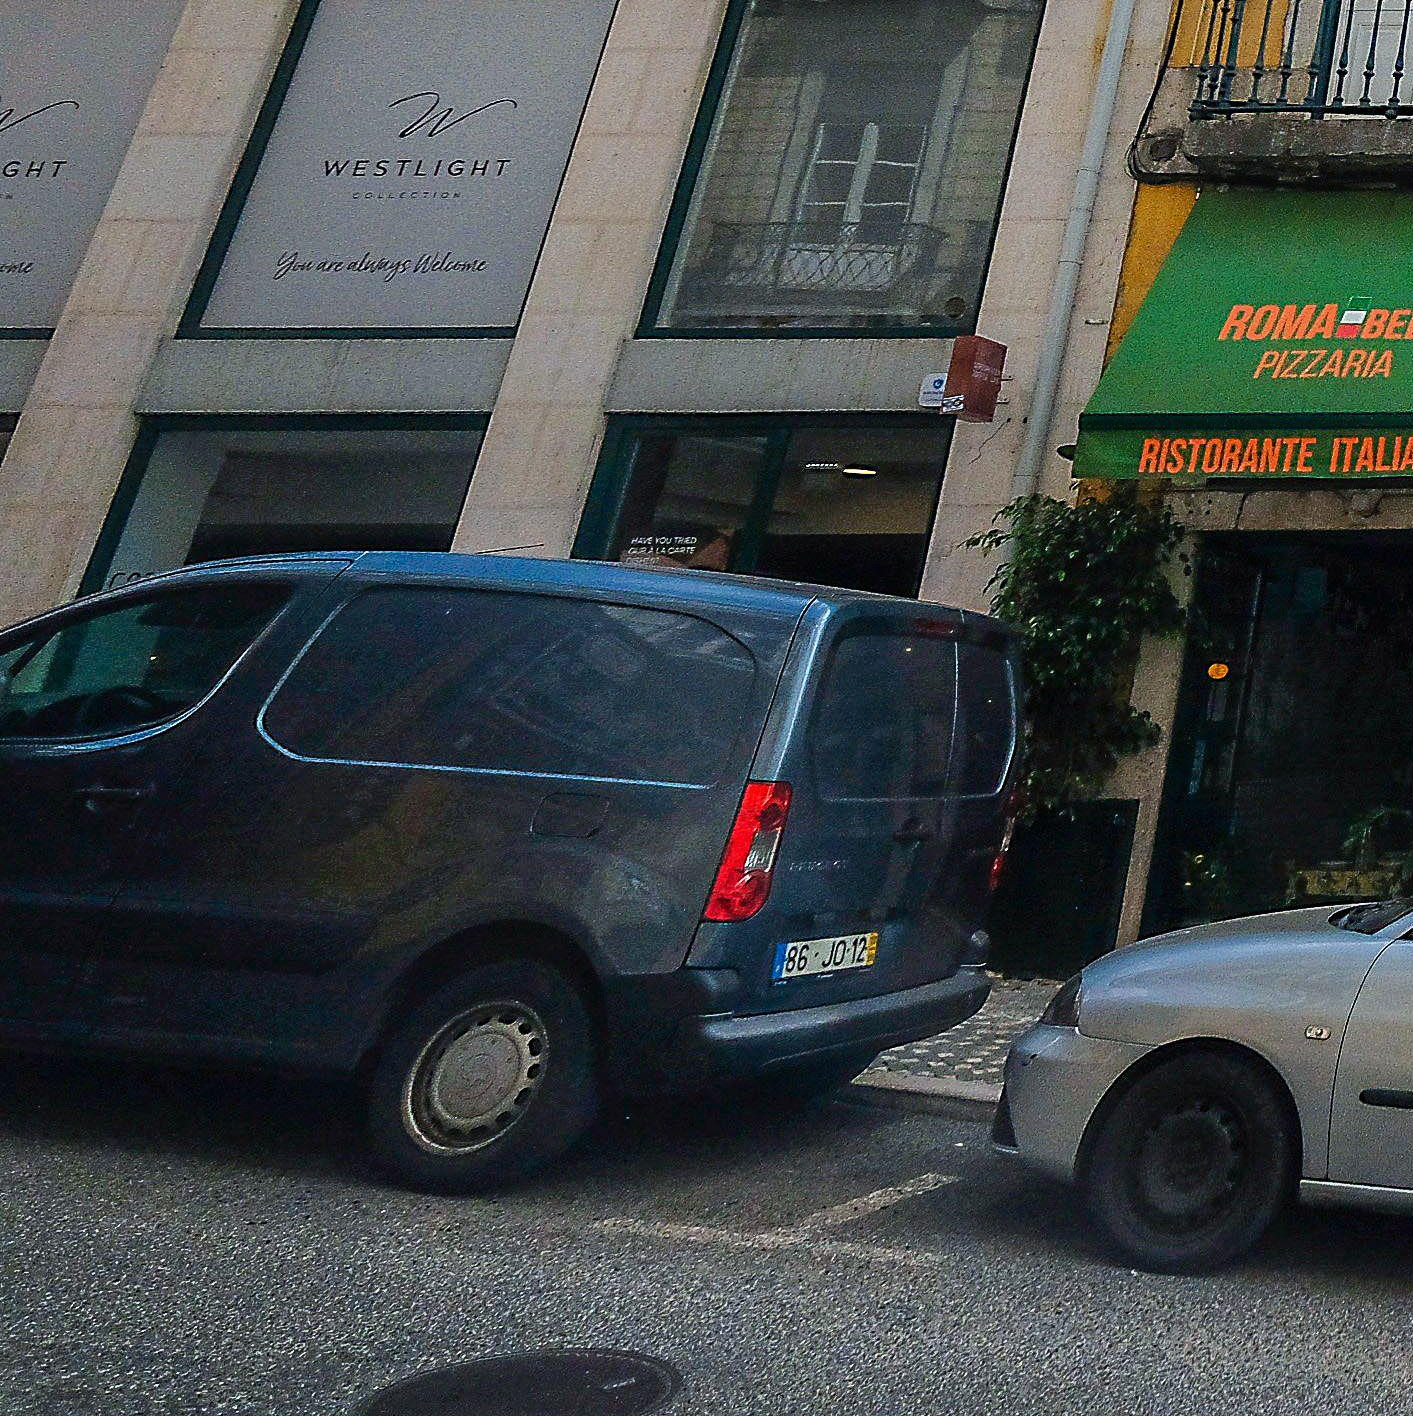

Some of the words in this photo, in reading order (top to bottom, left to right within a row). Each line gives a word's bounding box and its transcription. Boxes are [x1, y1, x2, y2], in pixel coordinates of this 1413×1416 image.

[324, 159, 511, 177] WESTLIGHT
[352, 191, 462, 200] COLLECTION
[273, 251, 313, 280] You
[316, 260, 344, 273] are
[347, 251, 411, 282] always
[413, 251, 488, 273] Welcome
[1217, 304, 1338, 341] ROMA
[1253, 349, 1394, 379] PIZZARIA
[1138, 437, 1316, 474] RISTORANTE
[631, 536, 653, 545] HAVE
[655, 536, 673, 545] YOU
[674, 536, 697, 545] TRIED
